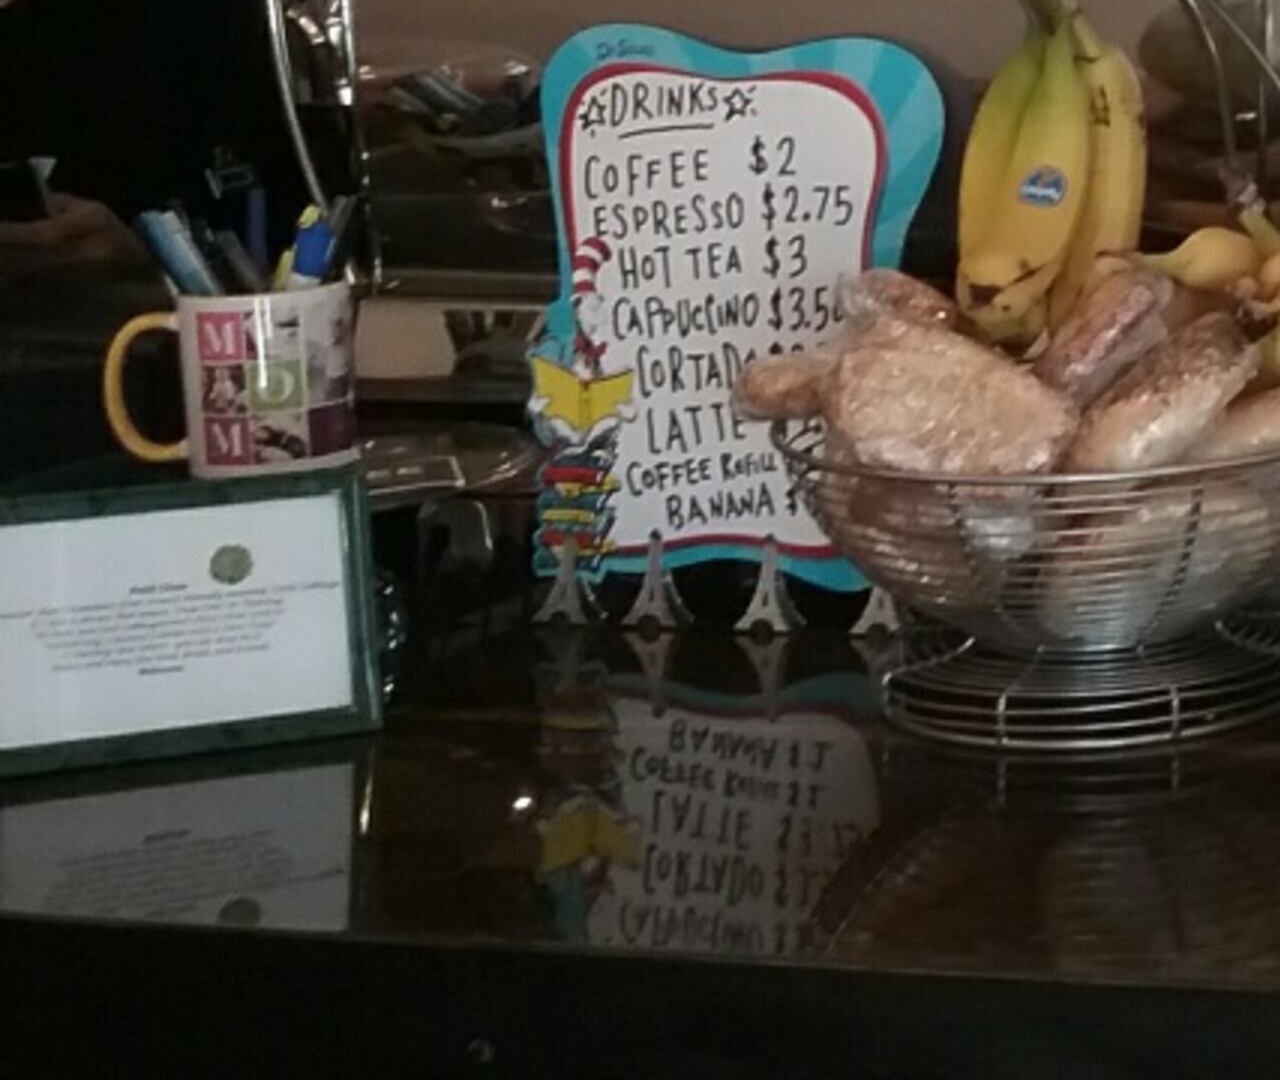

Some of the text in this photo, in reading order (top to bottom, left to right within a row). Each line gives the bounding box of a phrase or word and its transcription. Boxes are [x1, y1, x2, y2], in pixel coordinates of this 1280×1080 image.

[611, 82, 719, 127] DRINKS
[584, 134, 797, 200] COFFEE $2
[593, 182, 854, 241] ESPRESSO $2.75
[617, 233, 809, 290] HOT TEA $3
[612, 292, 761, 340] CAPPUCCINO
[636, 341, 757, 399] CORTAD
[646, 401, 747, 454] LATTE
[625, 457, 712, 497] COFFEE
[665, 482, 776, 531] BANANA
